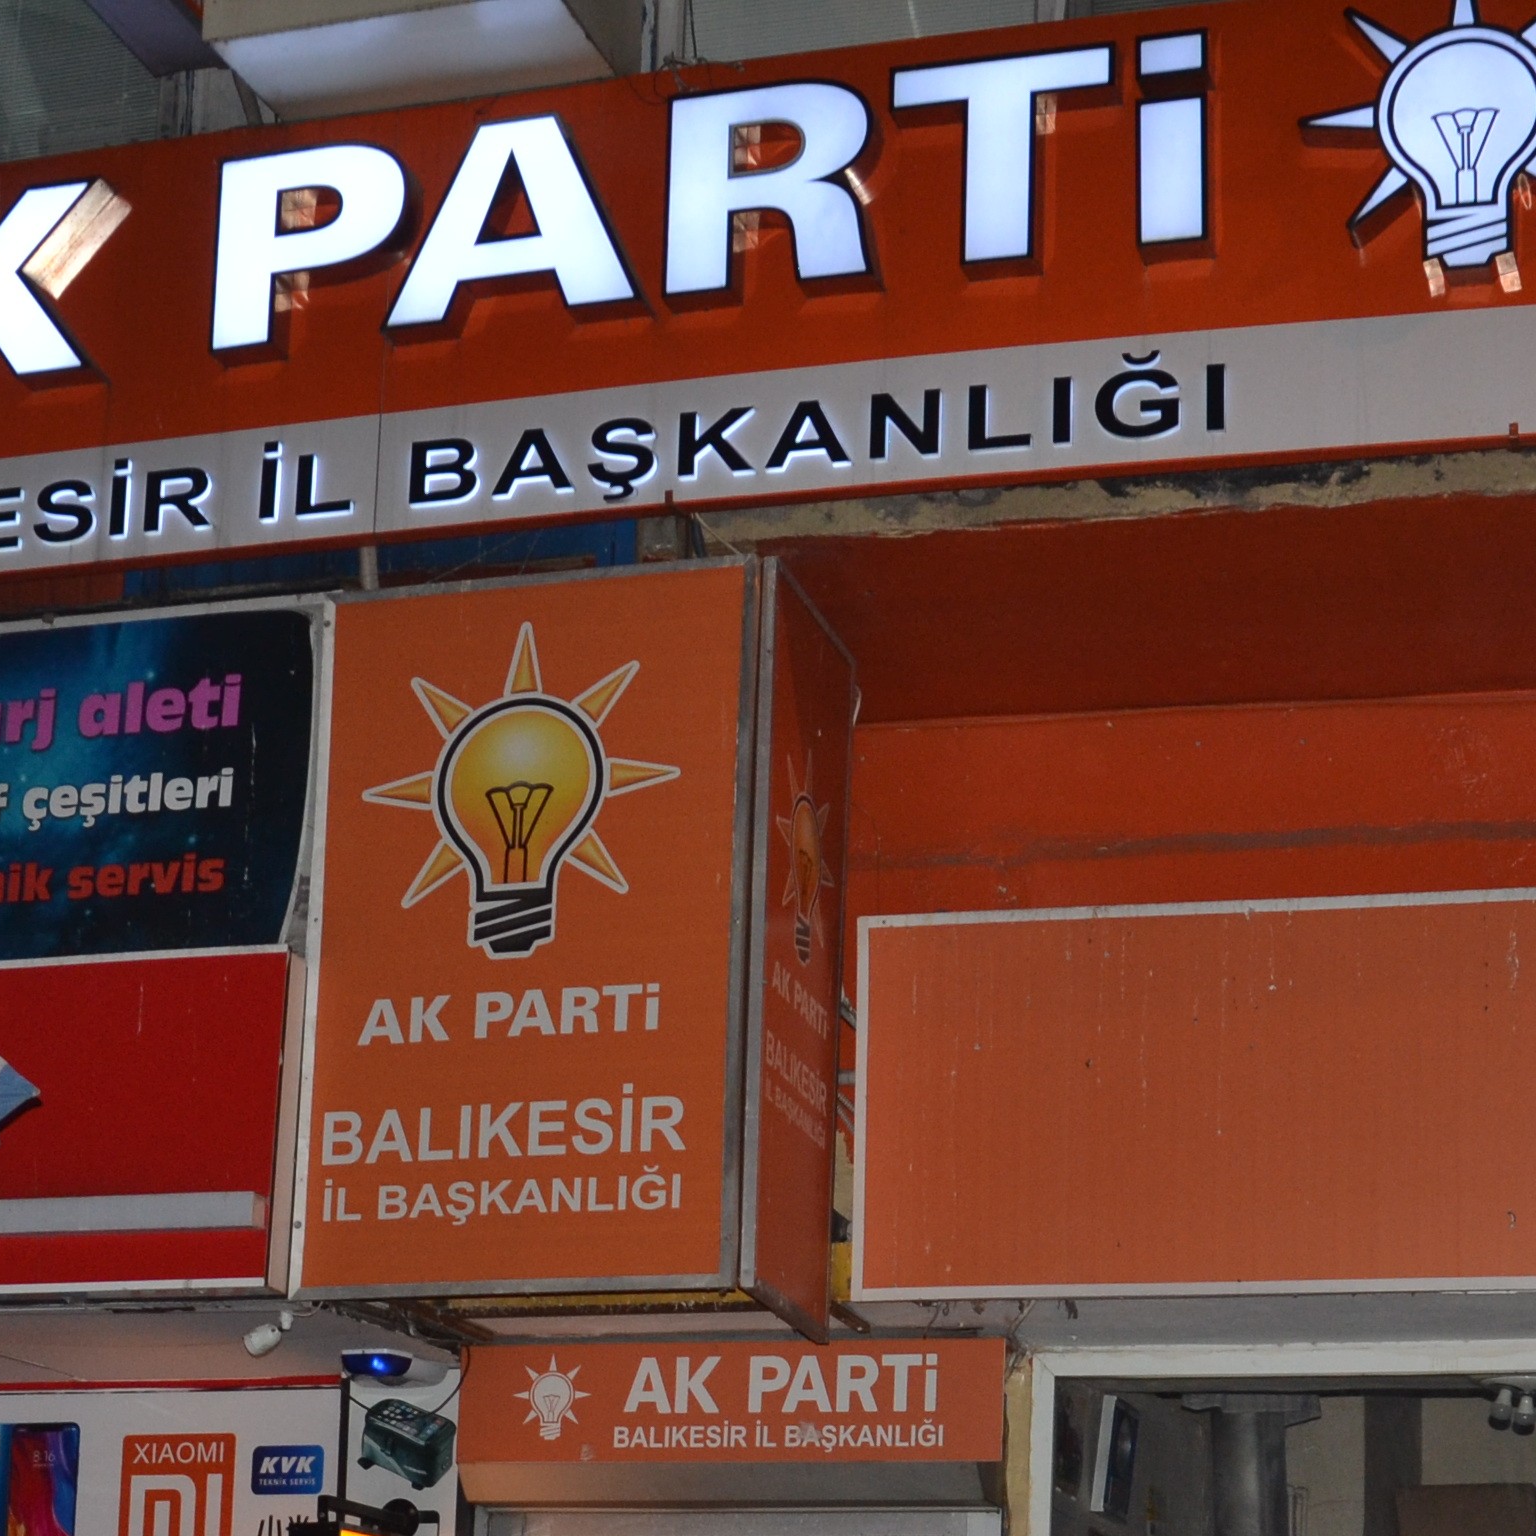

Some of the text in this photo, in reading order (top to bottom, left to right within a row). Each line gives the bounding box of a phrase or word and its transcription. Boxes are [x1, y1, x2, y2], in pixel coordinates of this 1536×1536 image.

[258, 440, 352, 522] İL
[407, 349, 1227, 502] BAŞKANLIĞI
[77, 673, 243, 738] aleti
[22, 767, 234, 831] çeşitleri
[67, 852, 225, 899] servis
[772, 960, 791, 1003] AK
[357, 994, 451, 1046] AK
[766, 1029, 827, 1117] BALIKESİR
[321, 1083, 686, 1166] BALIKESİR
[322, 1165, 681, 1226] İL BAŞKANLIĞI
[623, 1355, 722, 1414] AK
[133, 1441, 225, 1465] XIAOMI
[613, 1418, 945, 1452] BALIKESİR İL BAŞKANLIĞI
[260, 1456, 316, 1474] KVK
